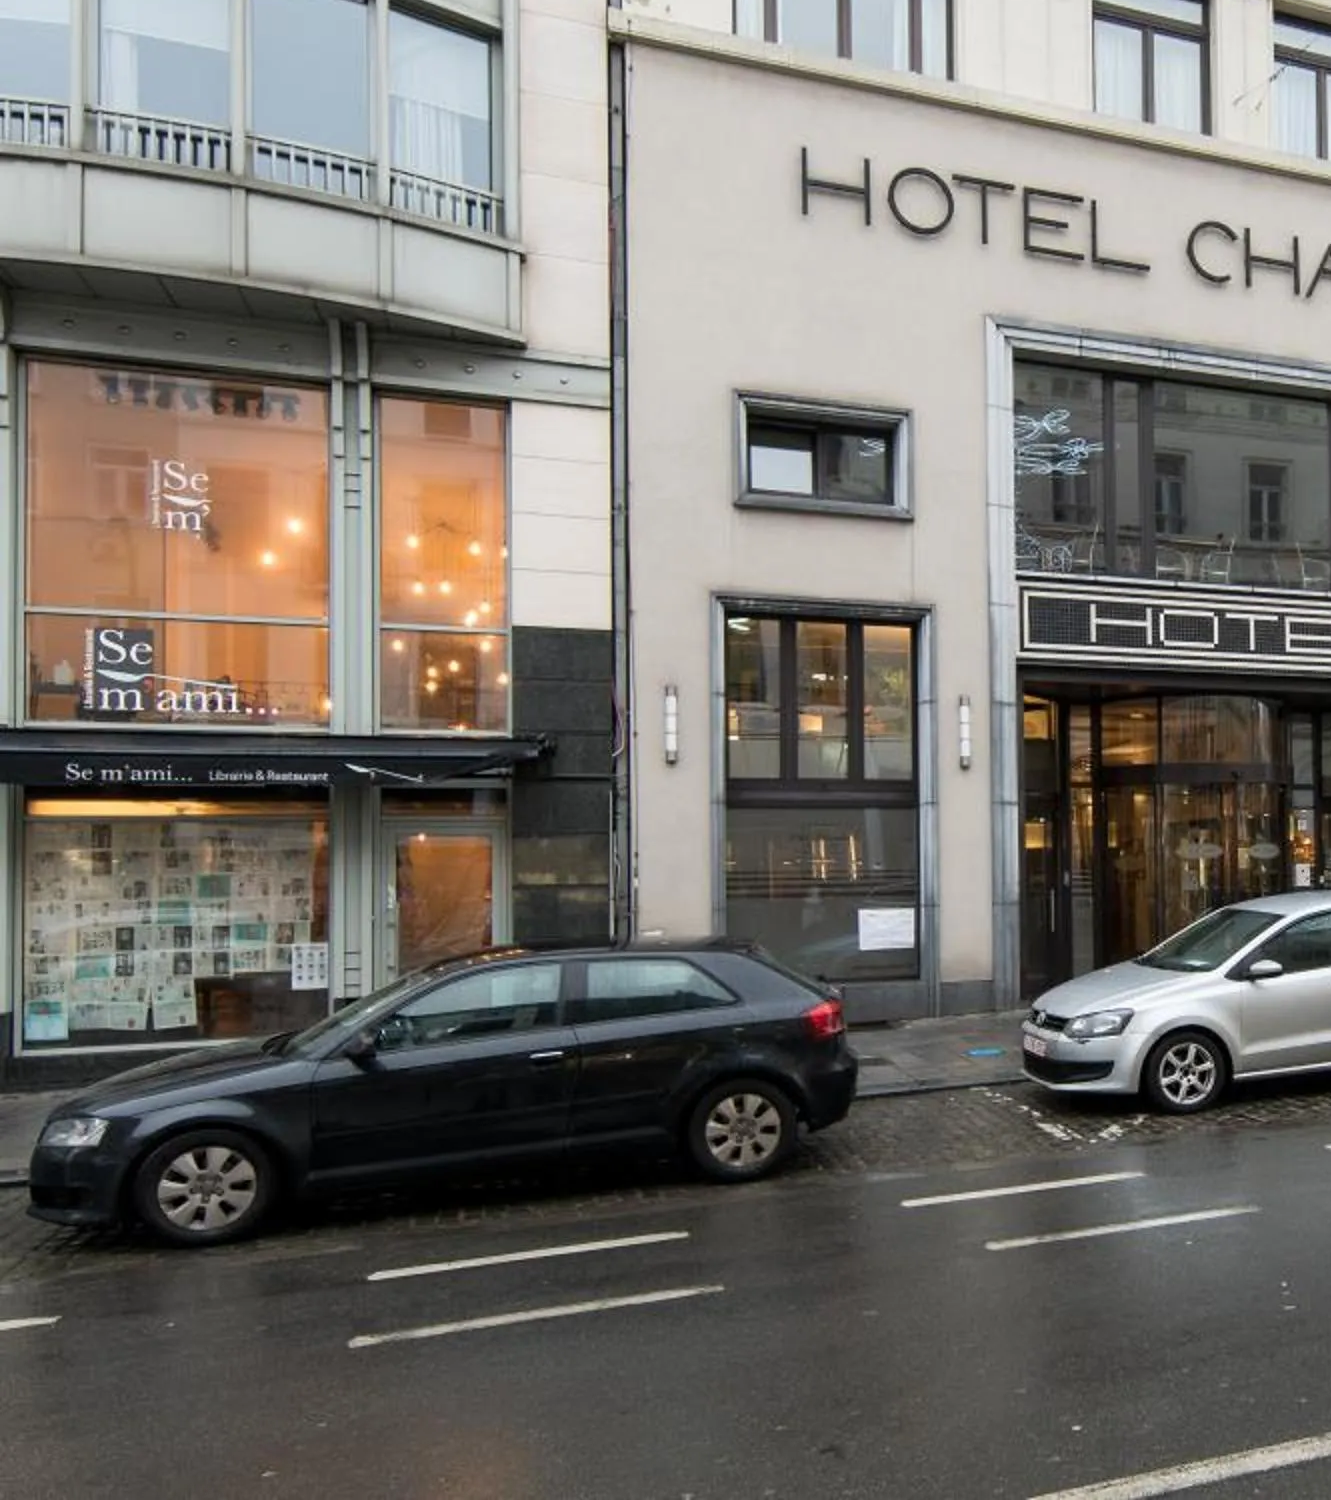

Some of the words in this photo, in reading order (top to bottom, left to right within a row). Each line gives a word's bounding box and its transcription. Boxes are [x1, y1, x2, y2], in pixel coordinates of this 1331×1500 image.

[801, 146, 1151, 273] HOTEL
[163, 459, 209, 493] Se
[98, 629, 154, 665] Se
[64, 762, 94, 781] Se
[255, 771, 265, 781] &
[266, 770, 329, 783] Restaurant
